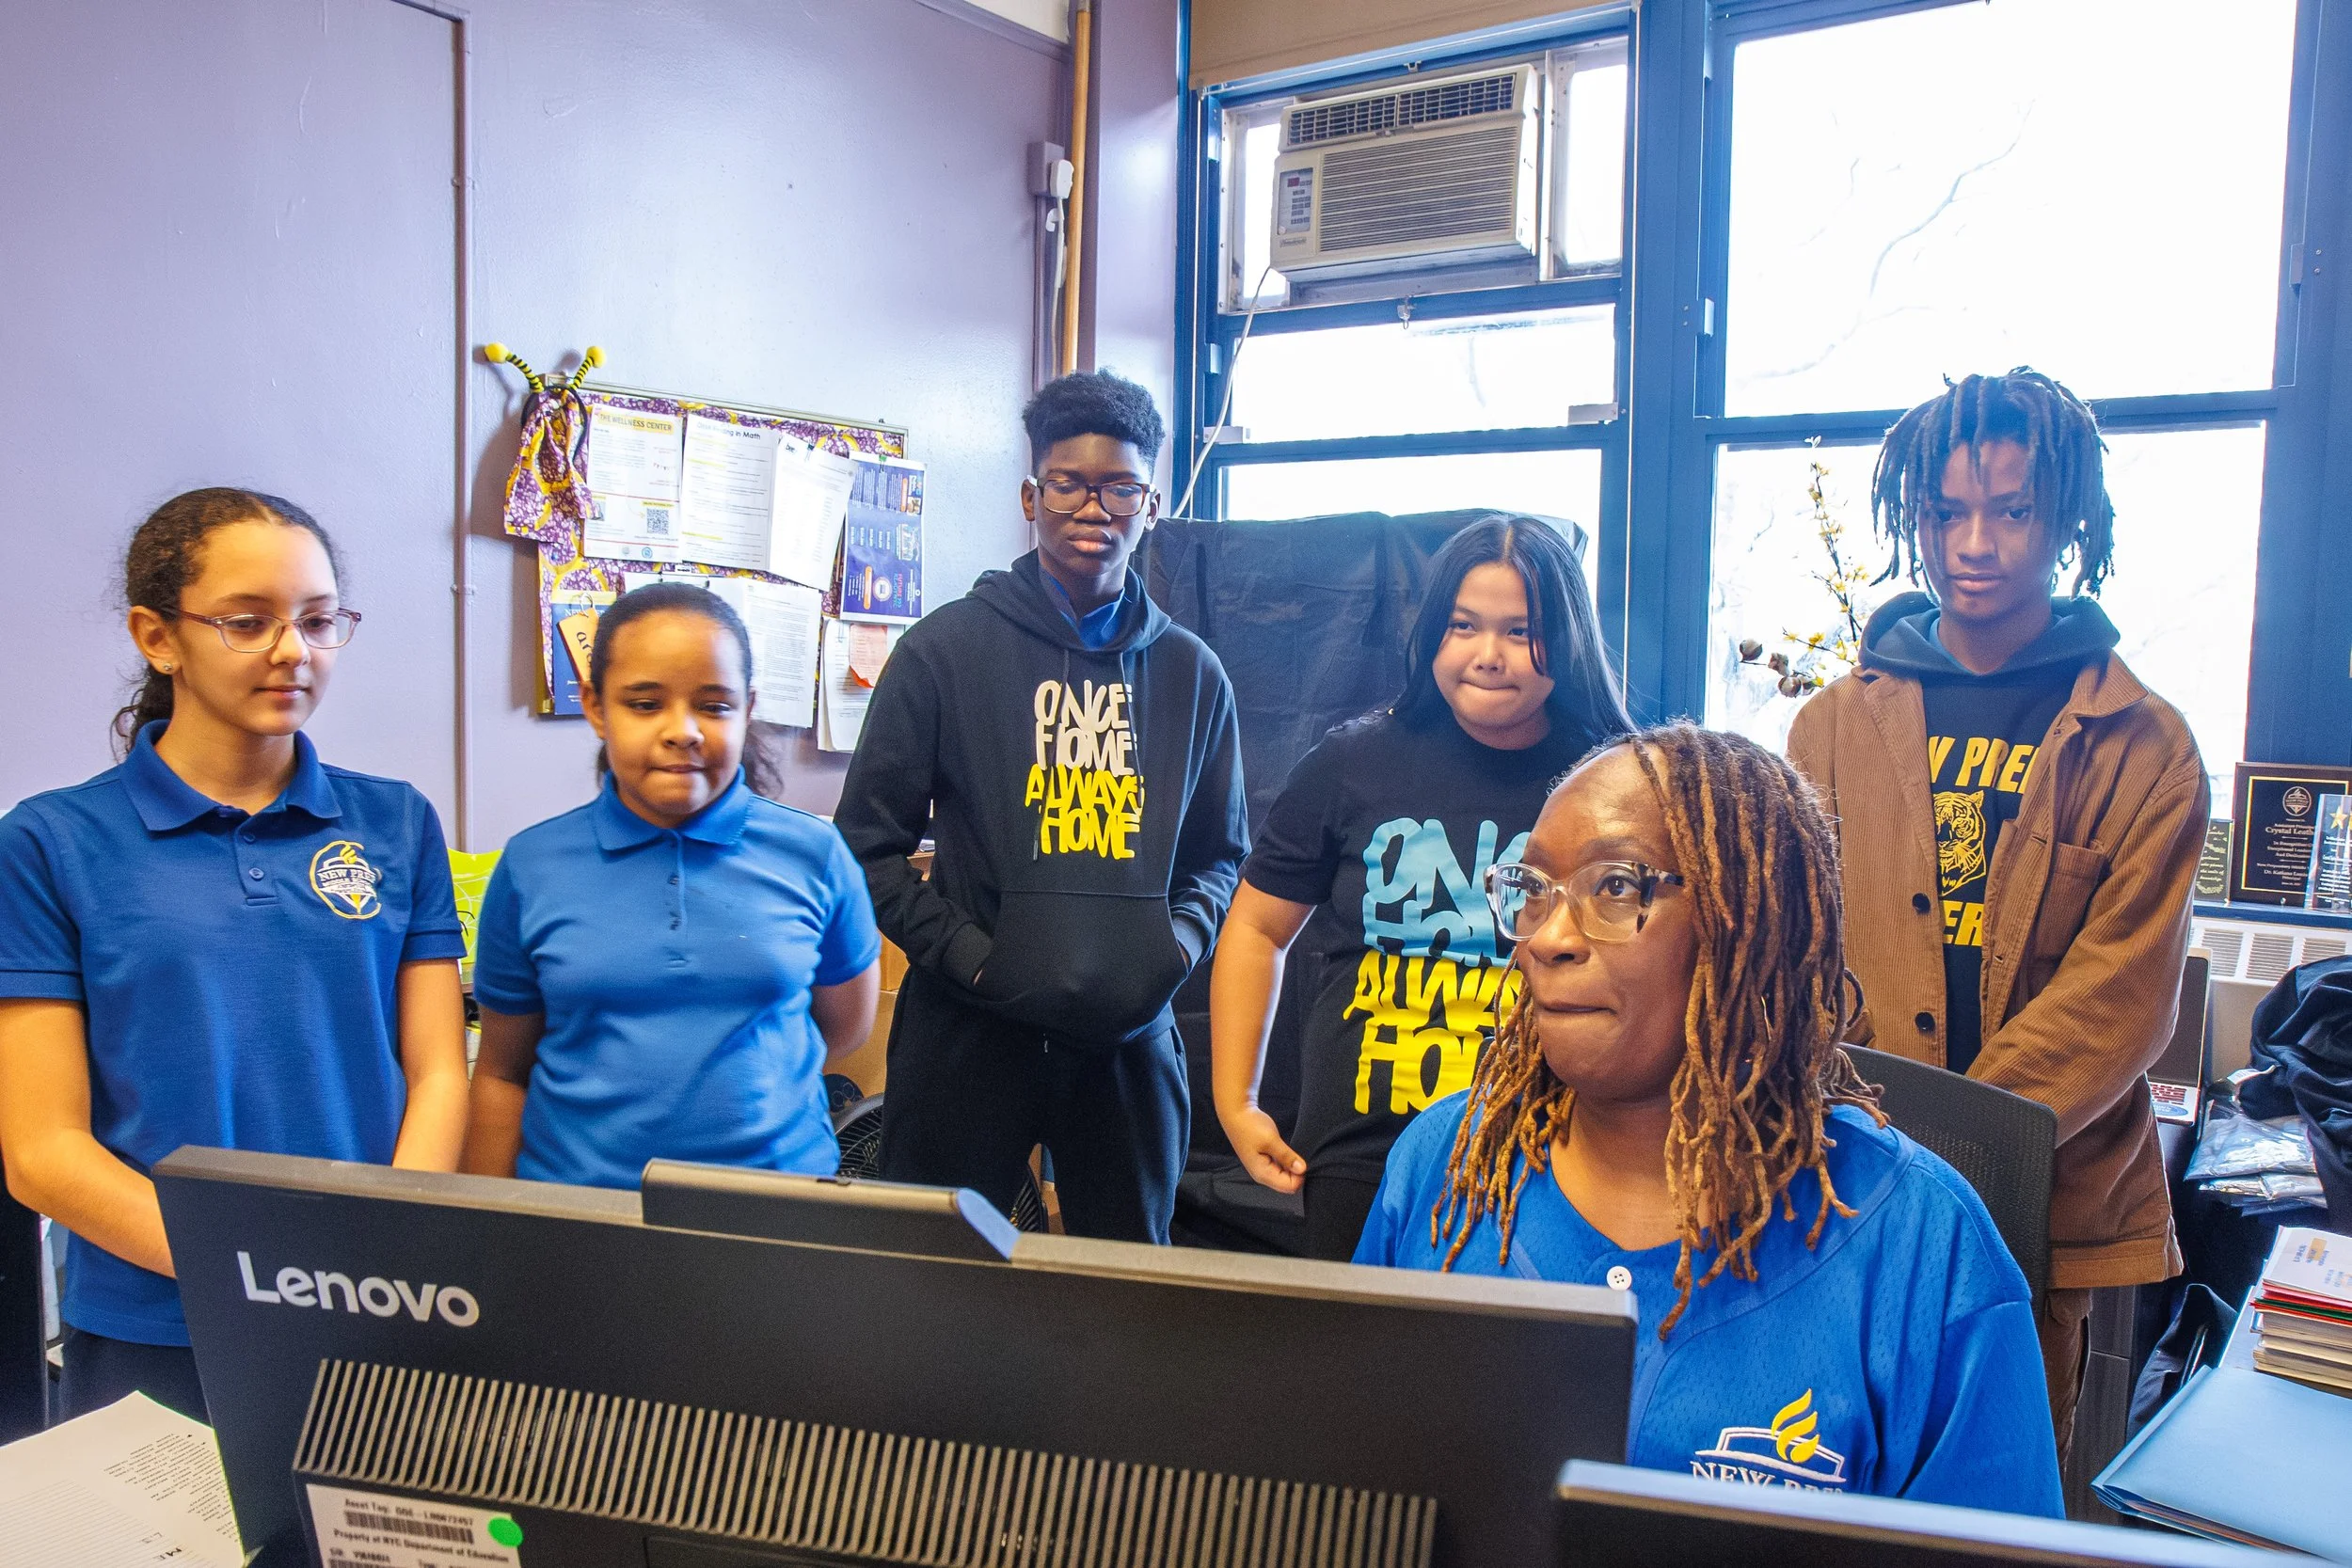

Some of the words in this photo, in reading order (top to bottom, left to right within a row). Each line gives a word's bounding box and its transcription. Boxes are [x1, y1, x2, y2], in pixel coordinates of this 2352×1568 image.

[612, 416, 644, 427] WELLNESS
[646, 422, 672, 431] CENTER
[1034, 679, 1132, 733] ONCE
[1041, 806, 1140, 860] HOME
[316, 867, 347, 882] NEW
[1362, 817, 1532, 913] ONC
[237, 1251, 480, 1327] Lenovo
[333, 1528, 370, 1543] Property
[404, 1539, 453, 1554] Department
[467, 1549, 509, 1562] Education
